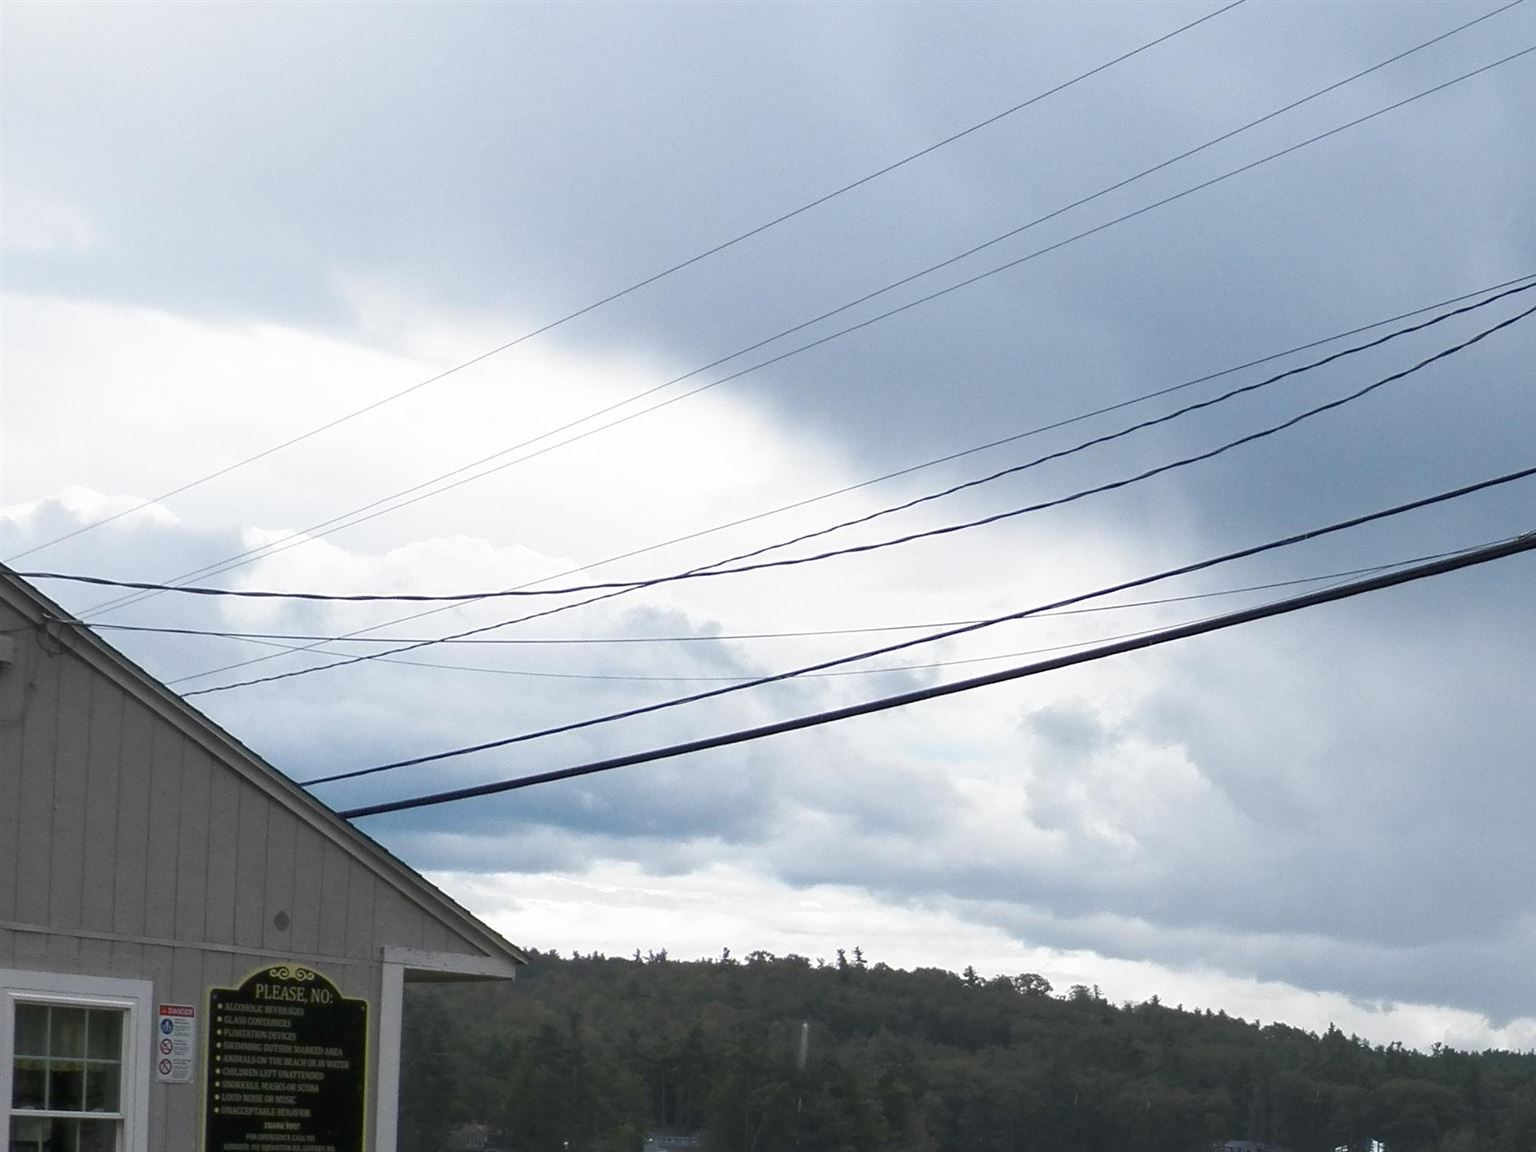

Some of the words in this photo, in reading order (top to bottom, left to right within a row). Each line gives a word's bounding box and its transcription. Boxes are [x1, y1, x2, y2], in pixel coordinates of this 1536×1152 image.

[255, 984, 308, 1003] PLEASE,
[311, 988, 333, 1004] NO:
[224, 1016, 246, 1026] GLASS
[247, 1018, 292, 1027] CONTAINERS
[223, 1042, 263, 1052] SWIMMING
[325, 1047, 343, 1056] AREA
[222, 1055, 257, 1064] ANIMALS
[257, 1057, 267, 1065] ON
[269, 1057, 283, 1066] THE
[284, 1058, 307, 1067] BEACH
[222, 1068, 259, 1078] CHILDREN
[260, 1069, 277, 1078] LEFT
[261, 1082, 285, 1091] MASKS
[221, 1093, 242, 1103] LOUD
[243, 1094, 264, 1103] NOISE
[275, 1095, 296, 1104] MUSIC
[221, 1106, 275, 1116] UNACCEPTABLE
